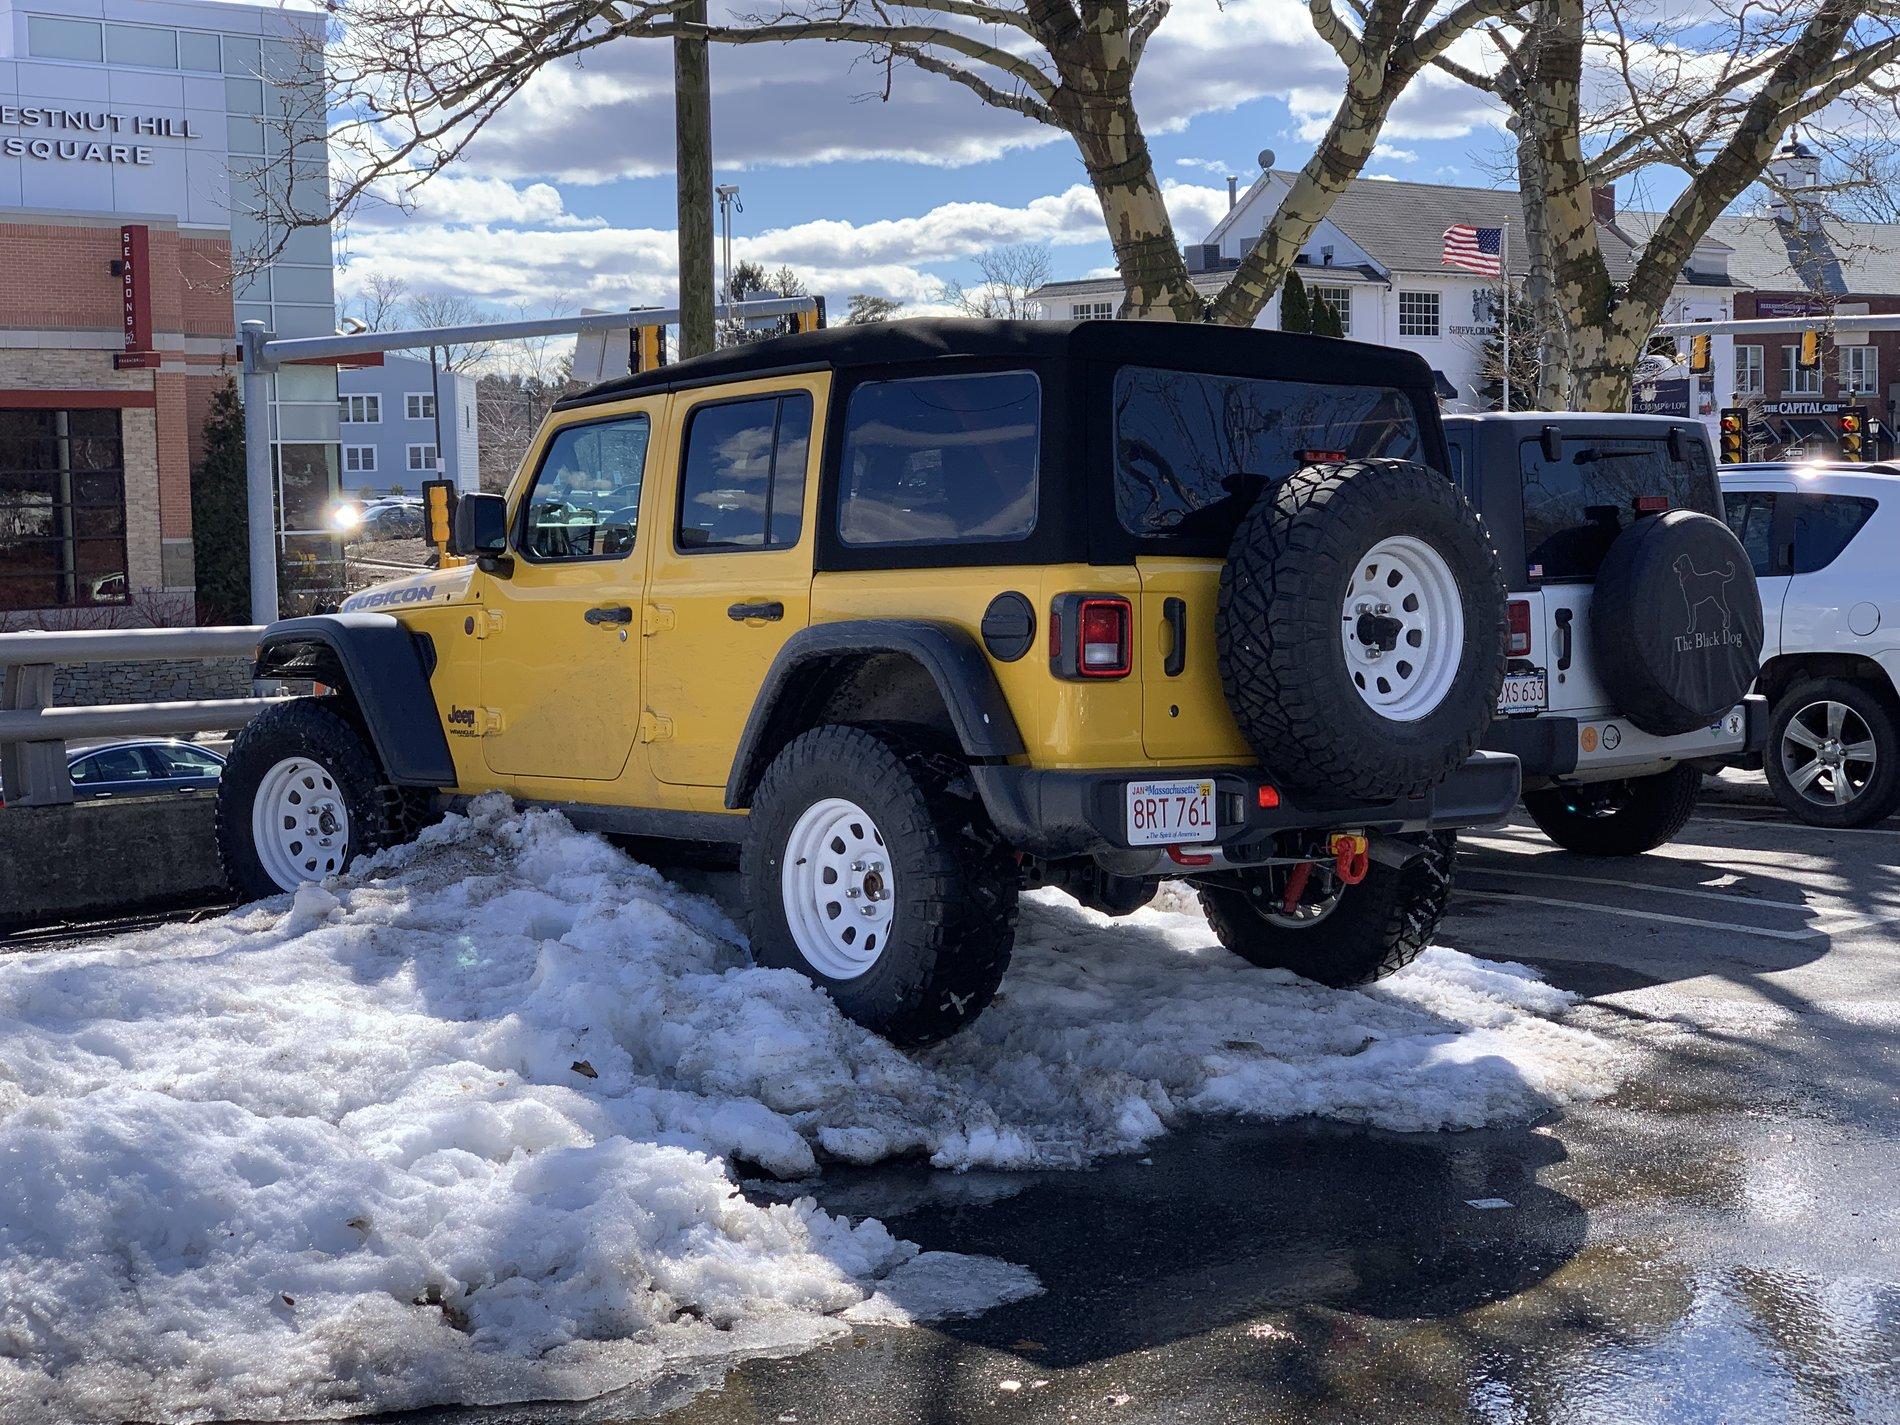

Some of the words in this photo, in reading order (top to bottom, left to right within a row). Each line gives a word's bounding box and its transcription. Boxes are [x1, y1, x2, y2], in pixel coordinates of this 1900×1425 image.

[134, 115, 202, 139] HILL
[5, 137, 154, 165] SQUARE
[123, 232, 134, 327] SEASONS
[1671, 401, 1688, 410] LOW
[1764, 404, 1779, 413] THE
[1779, 402, 1823, 414] CAPITAL
[343, 586, 436, 613] RUBICON
[1674, 636, 1693, 652] The
[1695, 631, 1720, 649] Black
[1722, 628, 1743, 648] Dog
[1522, 681, 1544, 702] 633
[448, 705, 475, 727] Jeep
[1132, 787, 1145, 795] JAN
[1147, 784, 1196, 796] Massachusetts
[1202, 788, 1210, 796] 21
[1134, 798, 1169, 829] 8RT
[1176, 796, 1211, 827] 761
